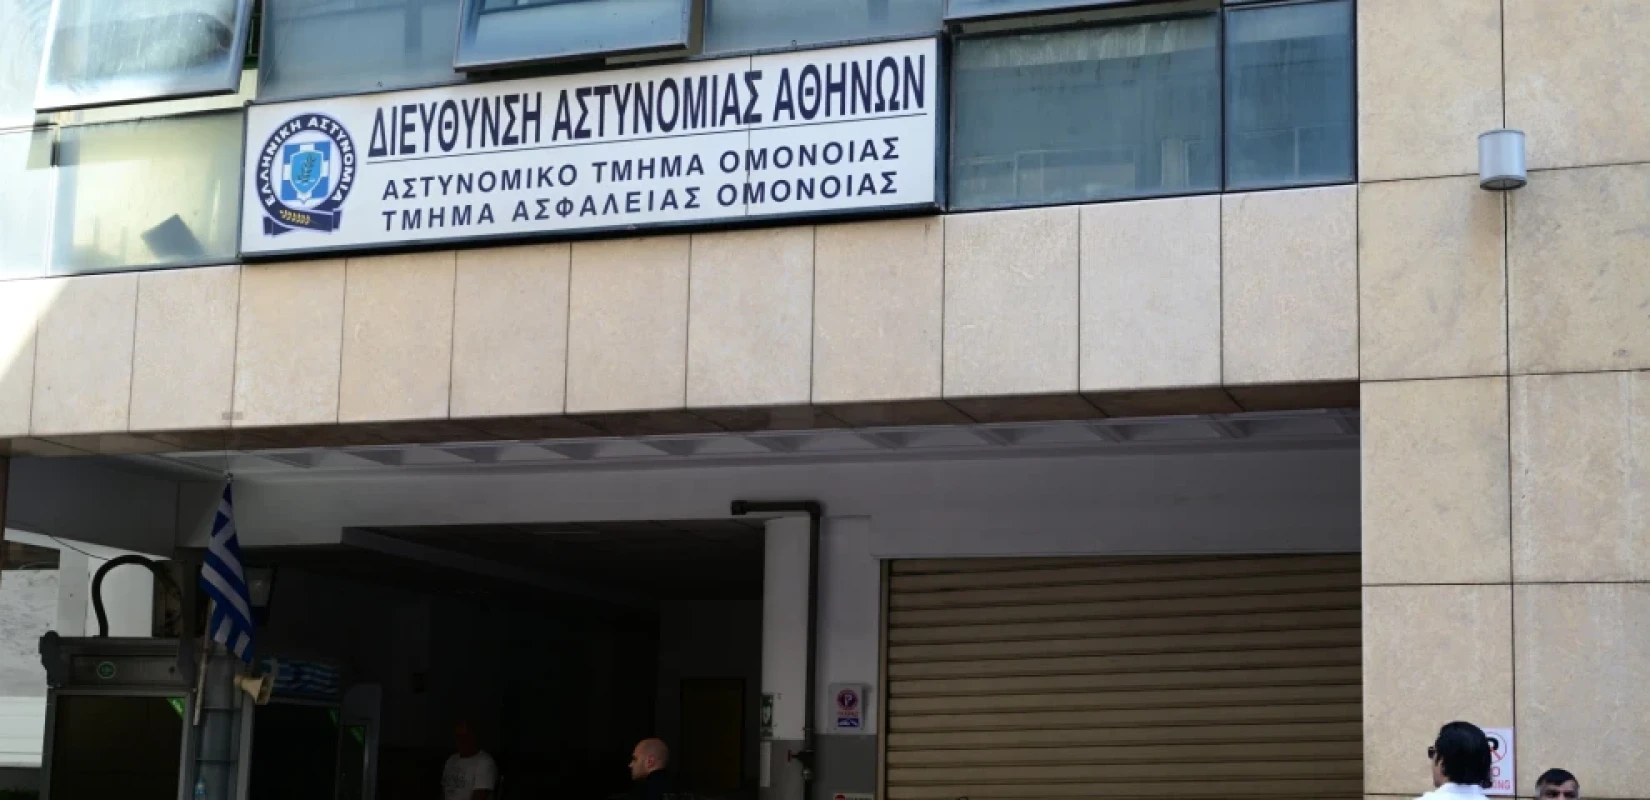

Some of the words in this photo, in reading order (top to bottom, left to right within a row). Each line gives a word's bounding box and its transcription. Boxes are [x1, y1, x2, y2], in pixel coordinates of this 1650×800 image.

[368, 92, 542, 158] ΔΙΕΥΘΥΝΣΗ
[552, 70, 762, 141] ΑΣΤΥΝΟΜΙΑΣ
[773, 54, 926, 121] ΑΘΗΝΩΝ
[260, 120, 301, 207] ΕΛΛΗΝΙΚΗ
[308, 116, 353, 201] ΑΣΤΥΝΟΜΙΑ
[382, 164, 577, 201] ΑΣΤΥΝΟΜΙΚΟ
[592, 154, 704, 183] ΤΜΗΜΑ
[719, 137, 899, 174] ΟΜΟΝΟΙΑΣ
[382, 203, 495, 232] ΤΜΗΜΑ
[512, 186, 701, 222] ΑΣΦΑΛΕΙΑΣ
[717, 171, 898, 206] ΟΜΟΝΟΙΑΣ
